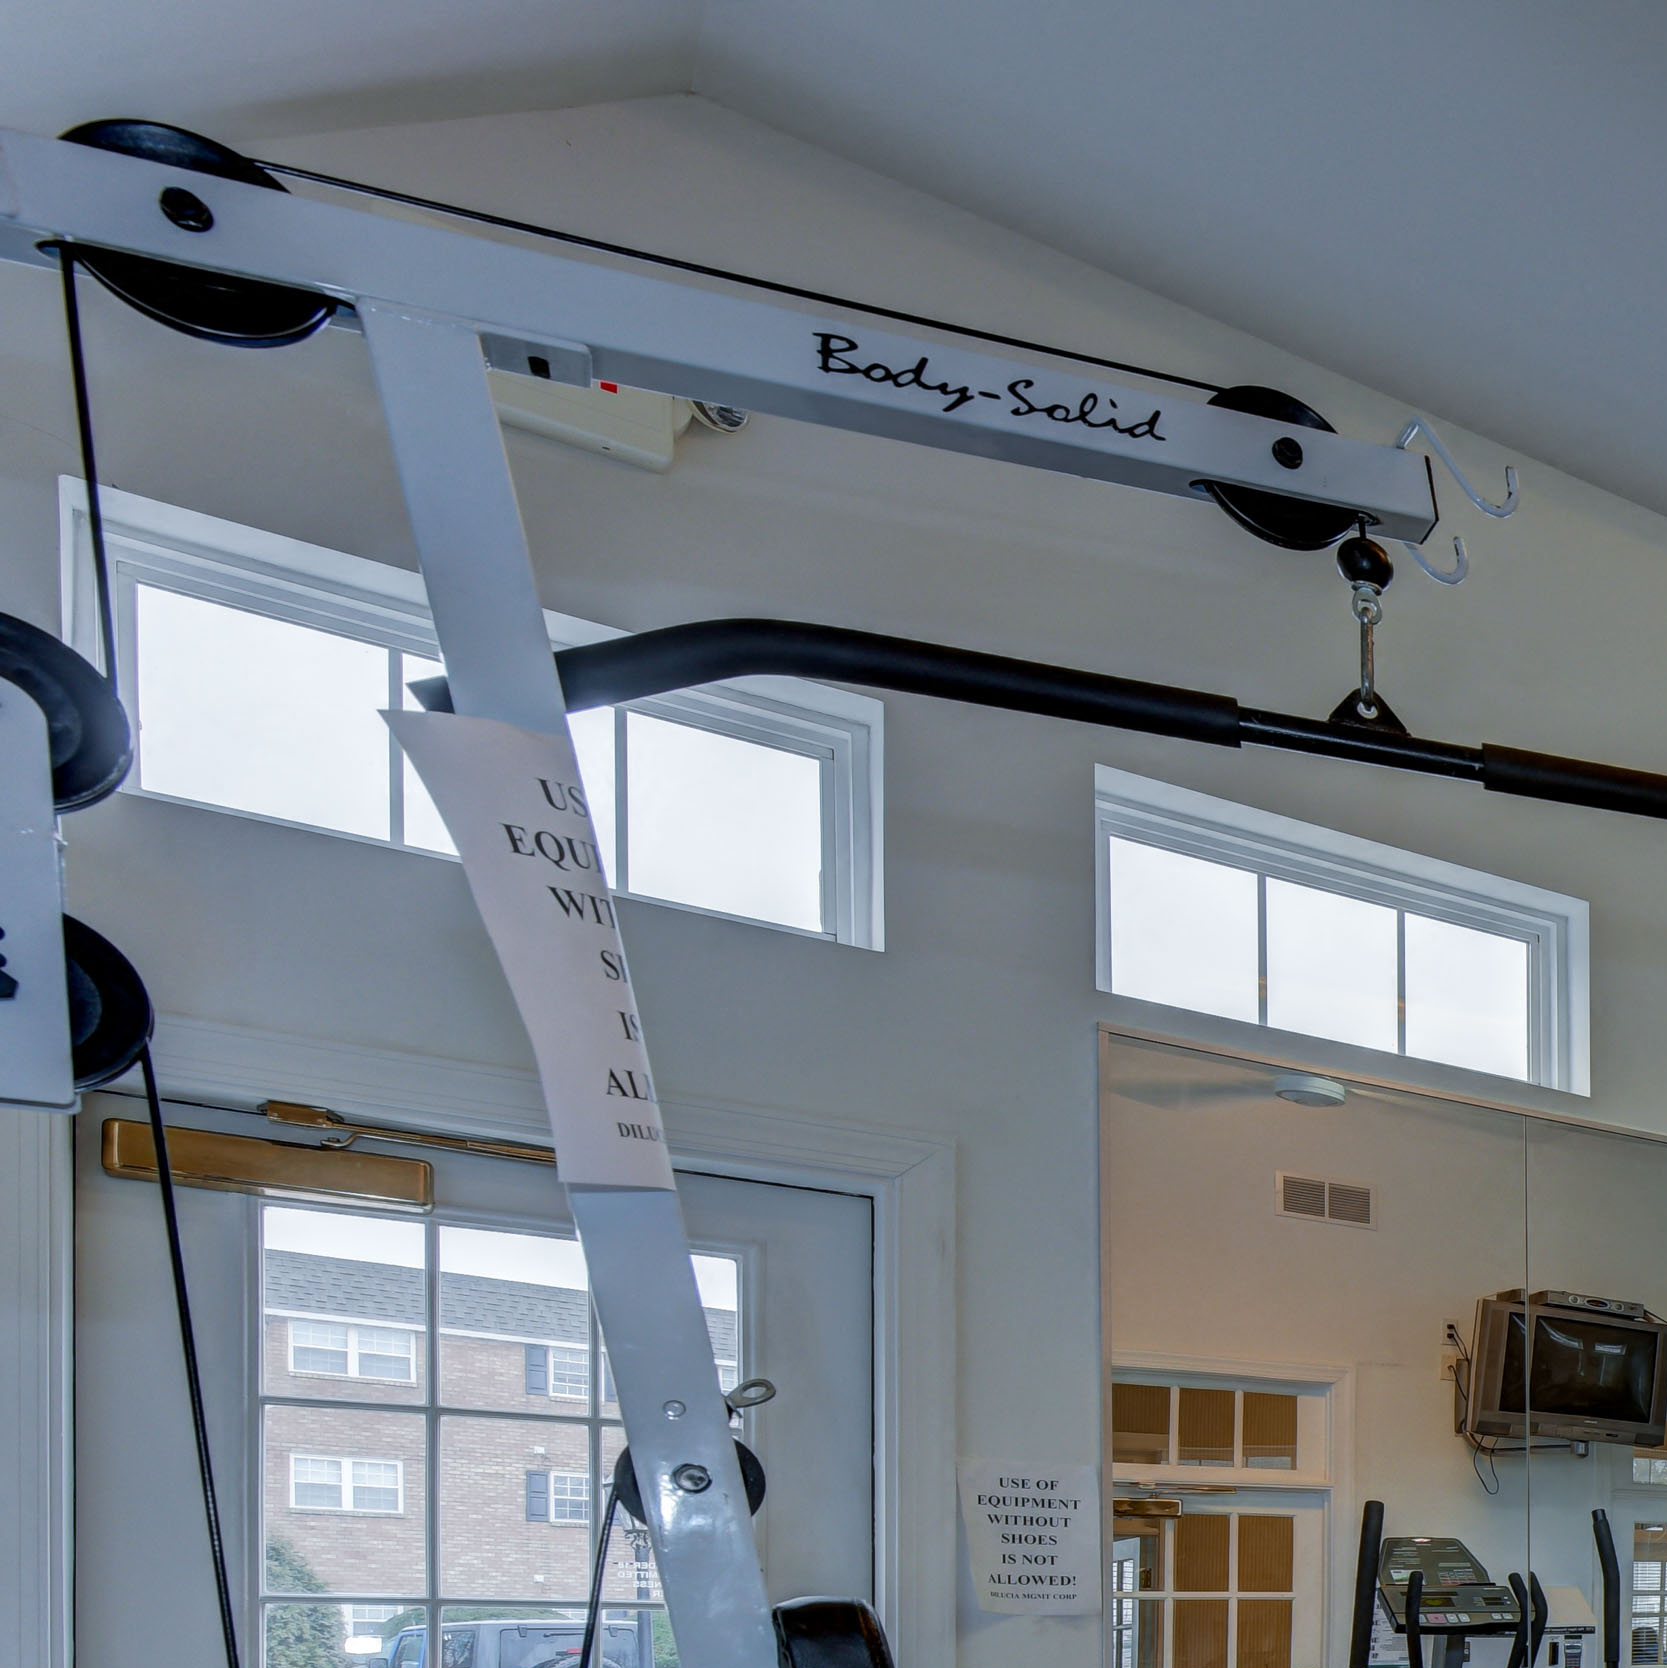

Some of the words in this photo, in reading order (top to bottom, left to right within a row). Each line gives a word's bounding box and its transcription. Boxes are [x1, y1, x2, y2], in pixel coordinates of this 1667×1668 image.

[812, 332, 1167, 442] Body-Solid
[999, 1477, 1031, 1490] USE
[1036, 1480, 1060, 1491] OF
[977, 1494, 1081, 1510] EQUIPMENT
[987, 1513, 1071, 1528] WITHOUT
[1001, 1533, 1057, 1546] SHOES
[1002, 1553, 1017, 1565] IS
[1022, 1554, 1058, 1566] NOT
[988, 1573, 1077, 1586] ALLOWED!
